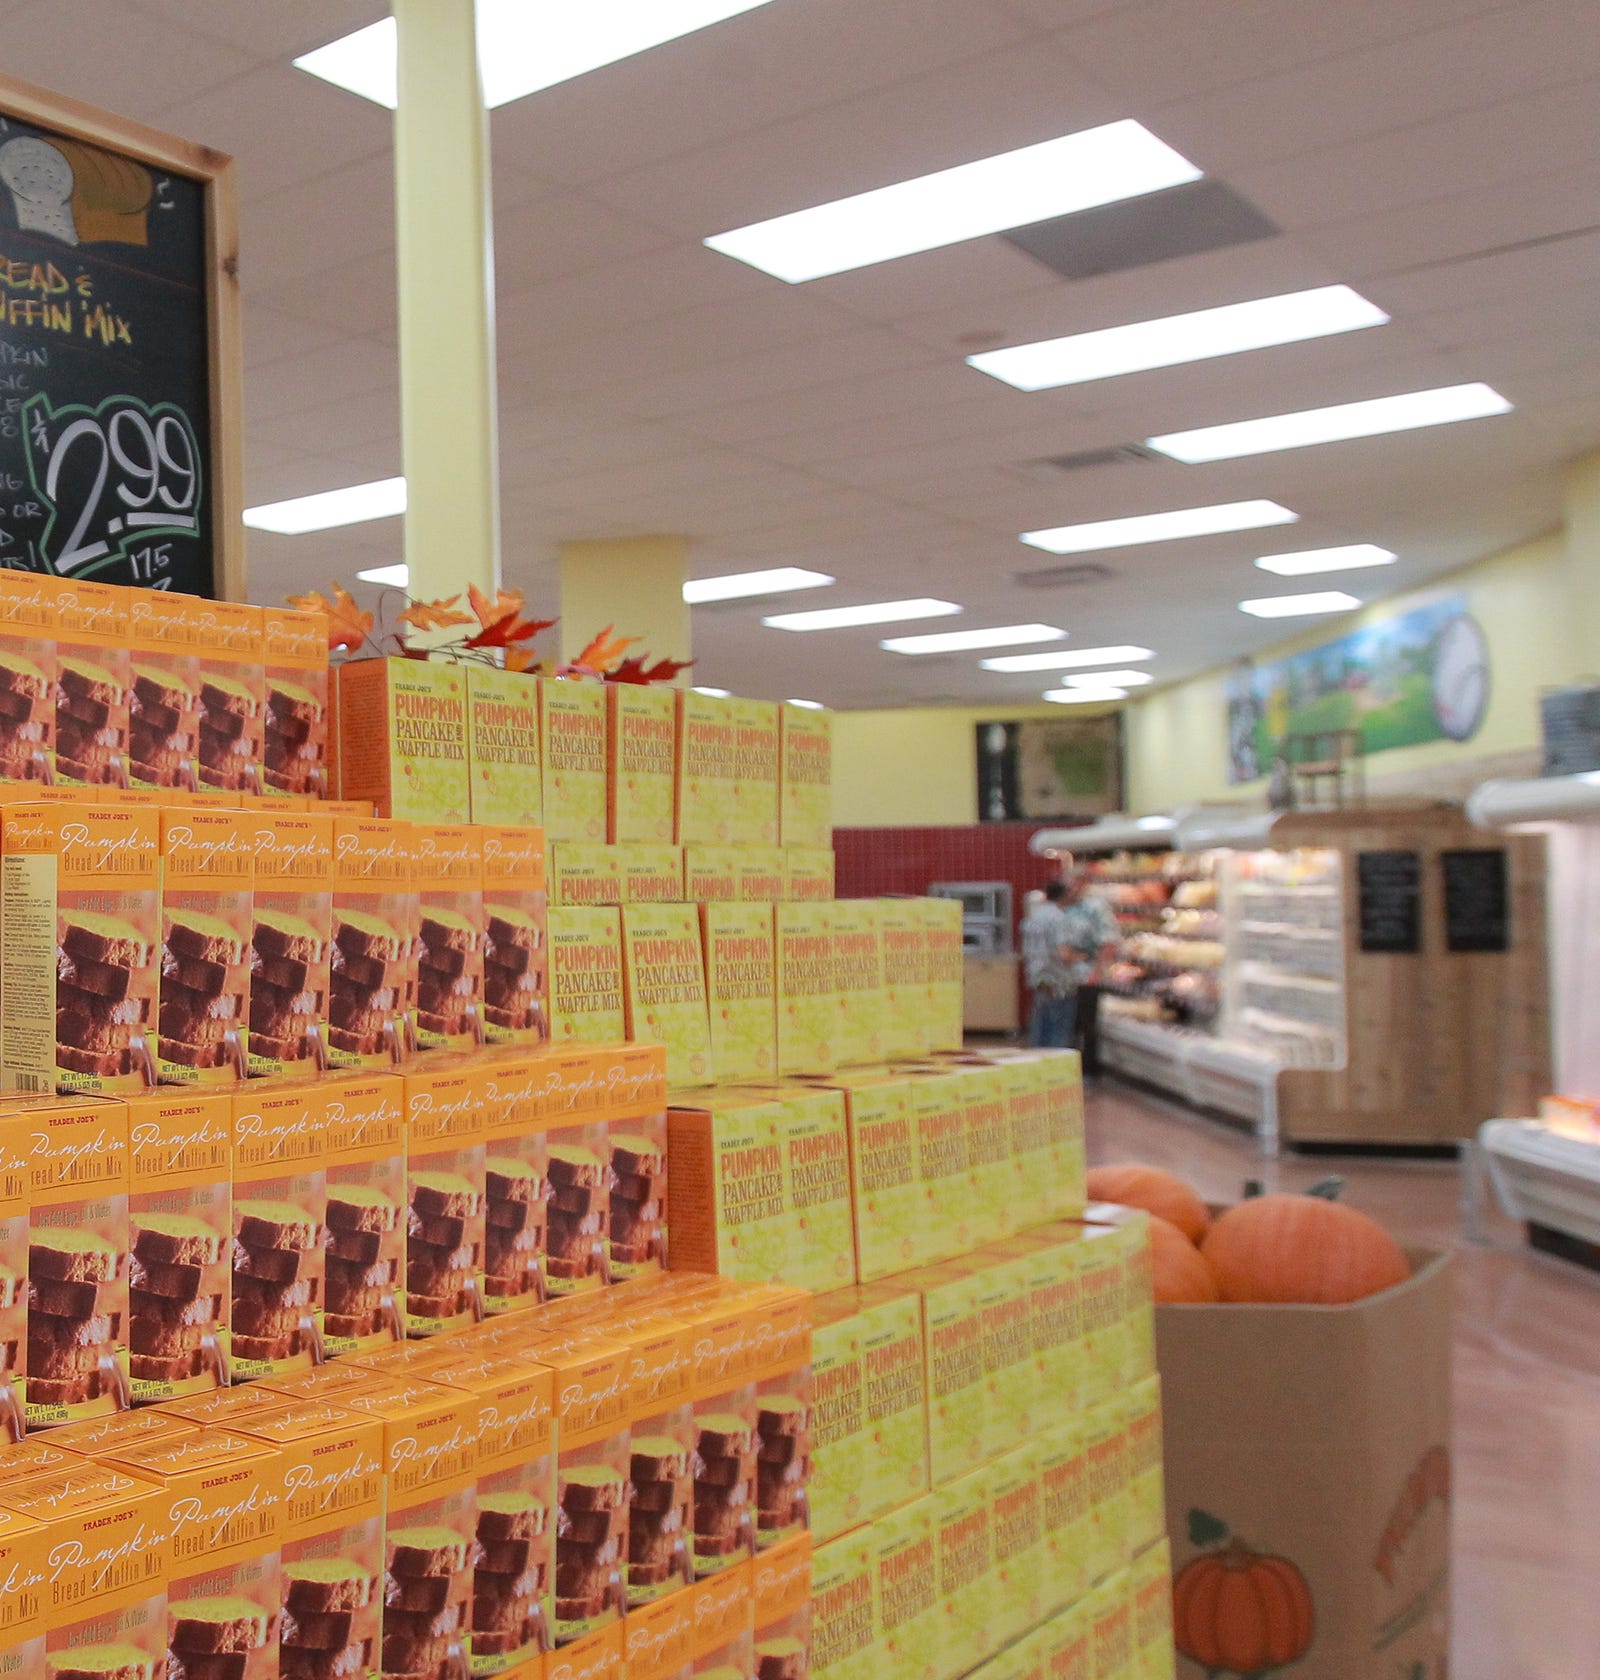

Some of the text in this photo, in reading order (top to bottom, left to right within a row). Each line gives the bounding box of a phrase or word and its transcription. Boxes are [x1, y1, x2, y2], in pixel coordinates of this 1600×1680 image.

[13, 503, 42, 516] OR
[395, 693, 463, 722] PUMPKIN
[474, 701, 534, 729] PUMPKIN
[396, 718, 455, 741] PANCAKE
[475, 726, 527, 747] PANCAKE
[397, 740, 464, 761] WAFFLE MIX
[476, 746, 536, 765] WAFFLE MIX
[554, 945, 618, 971] PUMPKIN
[556, 972, 612, 994] PANCAKE
[557, 993, 621, 1014] WAFFLE MIX
[721, 1144, 781, 1179] PUMPKIN
[723, 1174, 778, 1205] PANCAKE
[724, 1202, 765, 1225] WAFFLE
[19, 1597, 40, 1619] Mix
